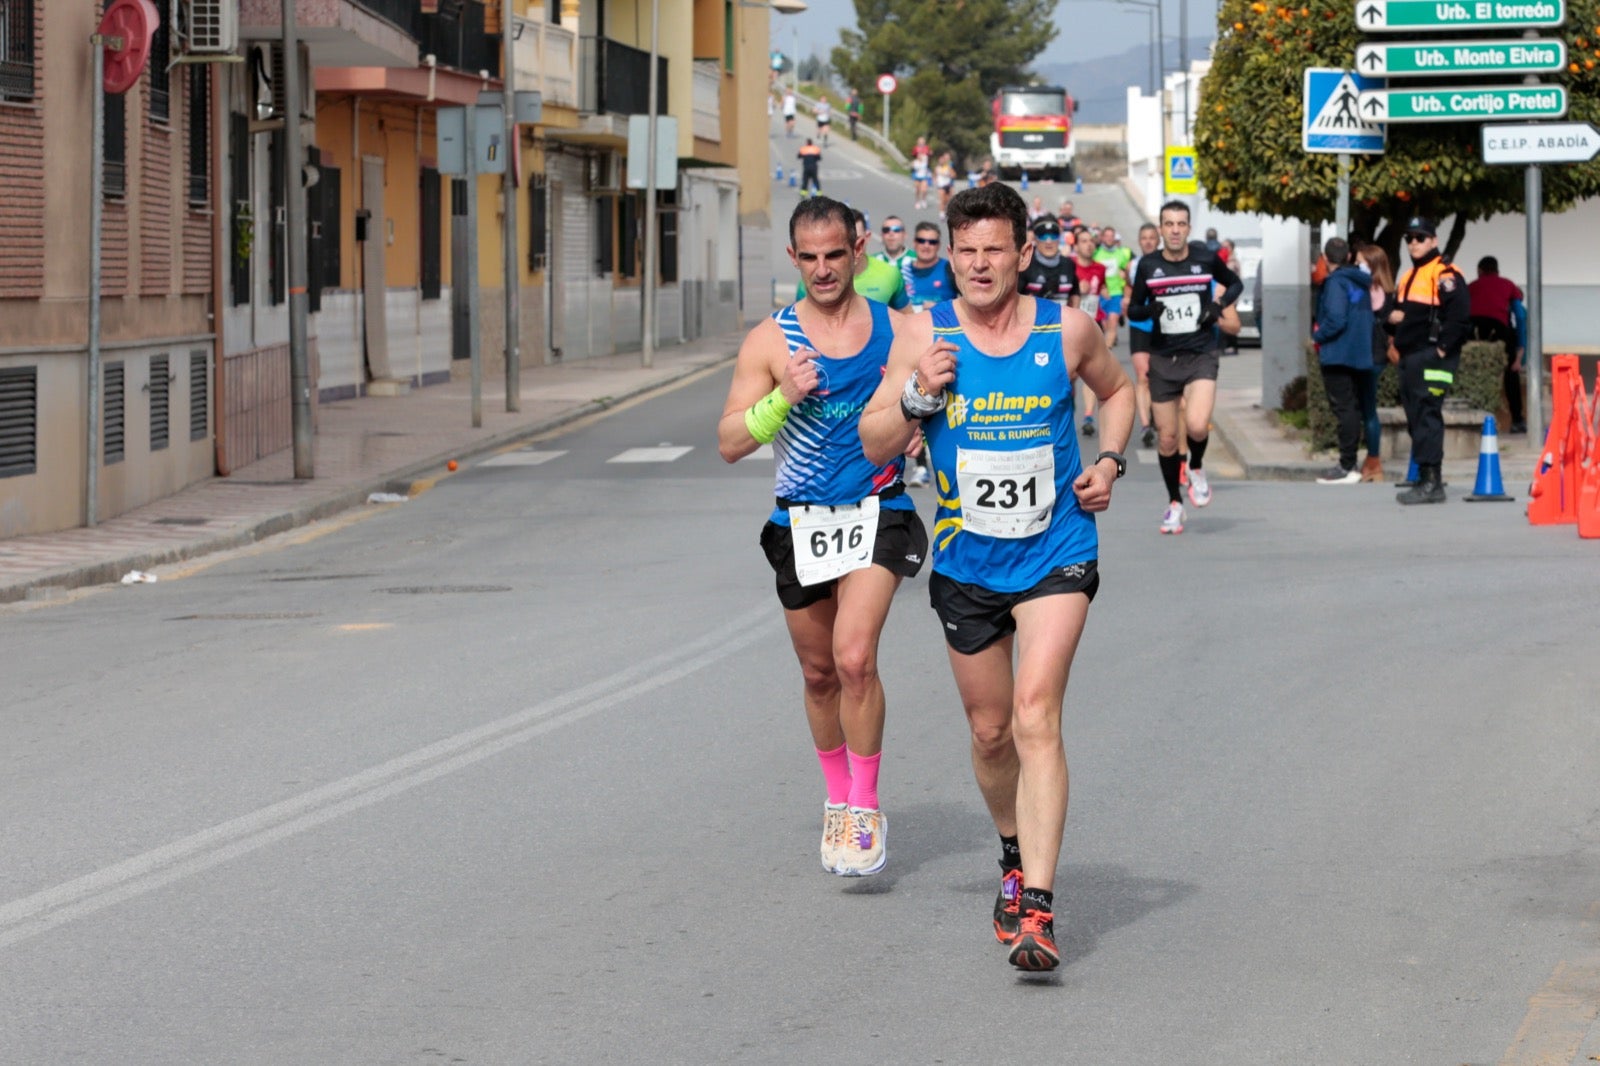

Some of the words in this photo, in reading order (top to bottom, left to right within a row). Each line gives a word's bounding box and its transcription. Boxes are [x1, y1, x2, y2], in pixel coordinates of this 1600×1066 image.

[1436, 2, 1470, 20] Urb.
[1475, 2, 1491, 19] El
[1496, 1, 1555, 18] torreón
[1415, 49, 1449, 67] Urb.
[1454, 48, 1505, 65] Monte
[1509, 47, 1555, 64] Elvira
[1411, 95, 1446, 113] Urb.
[1450, 94, 1504, 114] Cortijo
[1508, 92, 1557, 110] Pretel
[1488, 138, 1531, 150] C.E.I.P.
[1537, 134, 1589, 148] ABADÍA
[1166, 305, 1194, 321] 814
[973, 392, 1052, 413] olimpo
[970, 412, 1022, 425] deportes
[967, 431, 997, 441] TRAIL
[998, 431, 1006, 440] &
[1008, 427, 1051, 440] RUNNING
[975, 476, 1037, 509] 231
[810, 524, 864, 558] 616
